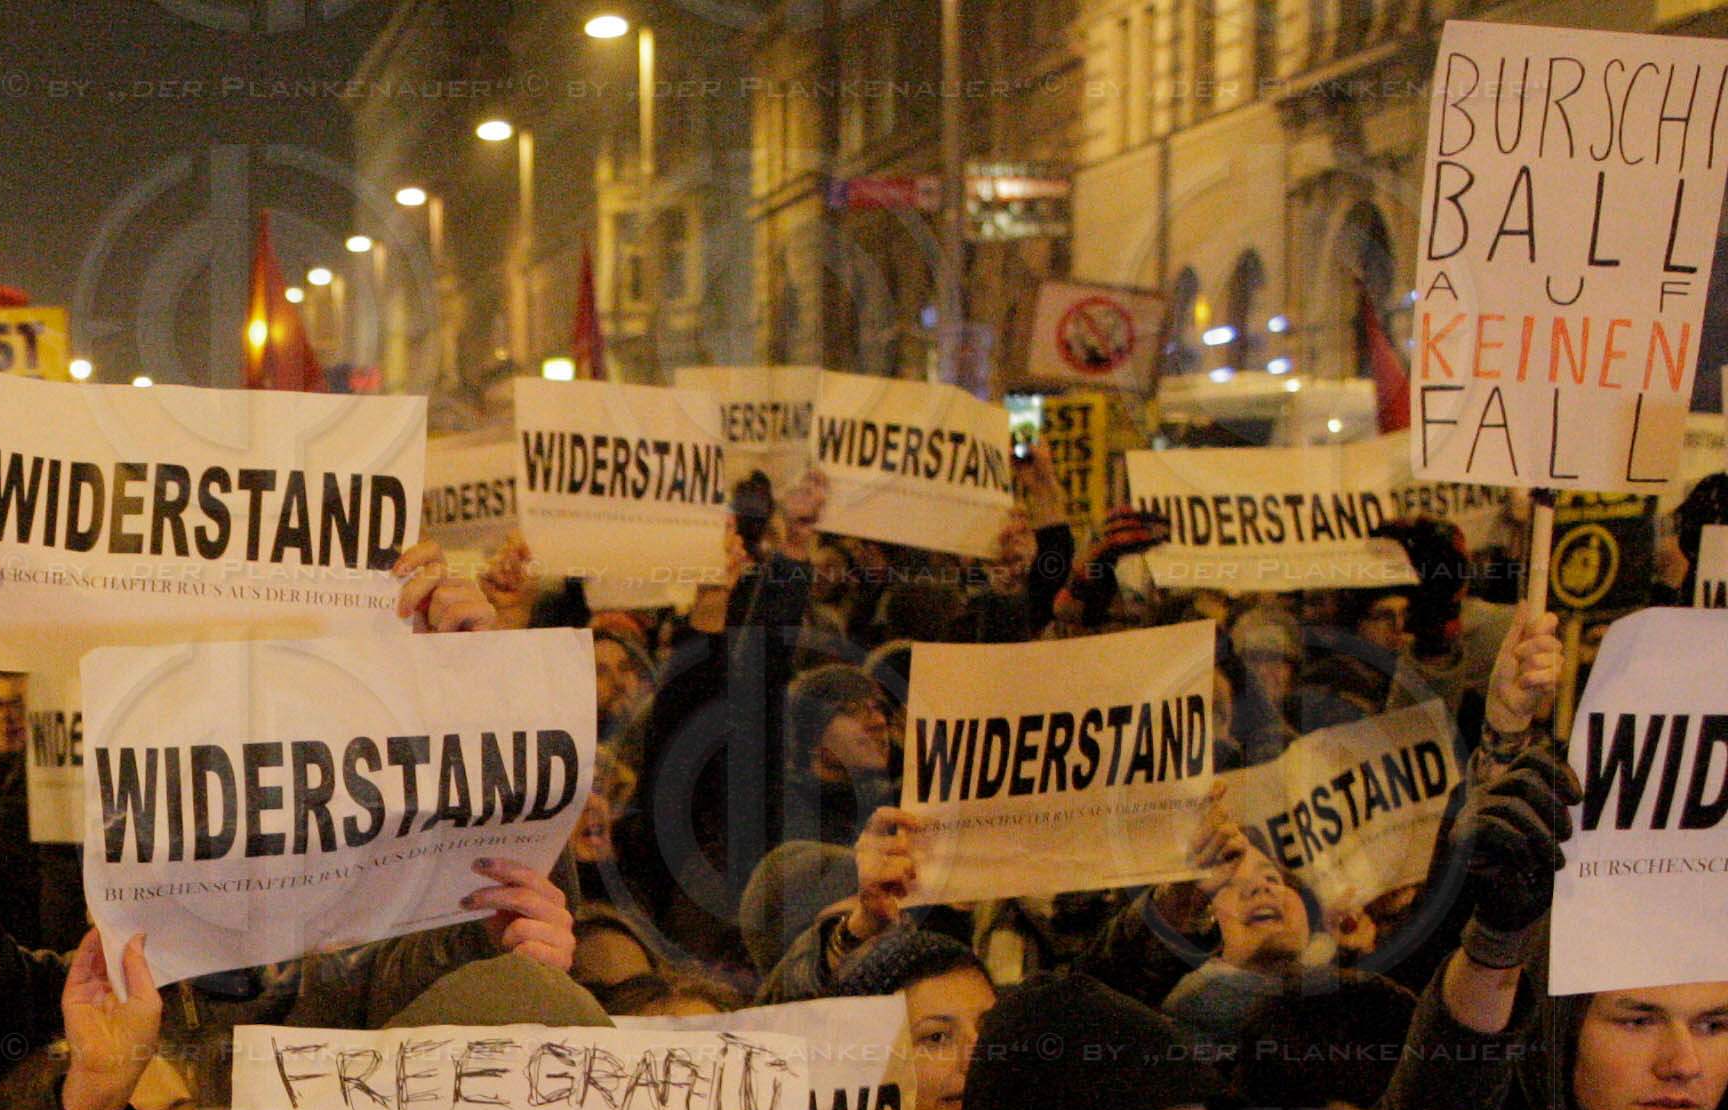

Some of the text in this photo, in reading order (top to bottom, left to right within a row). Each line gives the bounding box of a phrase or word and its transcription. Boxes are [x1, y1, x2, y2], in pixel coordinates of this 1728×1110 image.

[1428, 160, 1698, 274] BALL
[1424, 270, 1692, 313] AUF
[1420, 312, 1692, 392] KEINEN
[1420, 384, 1670, 484] FALL
[266, 587, 302, 604] DER
[95, 729, 579, 864] WIDERSTAND
[915, 693, 1207, 804] WIDERSTAND
